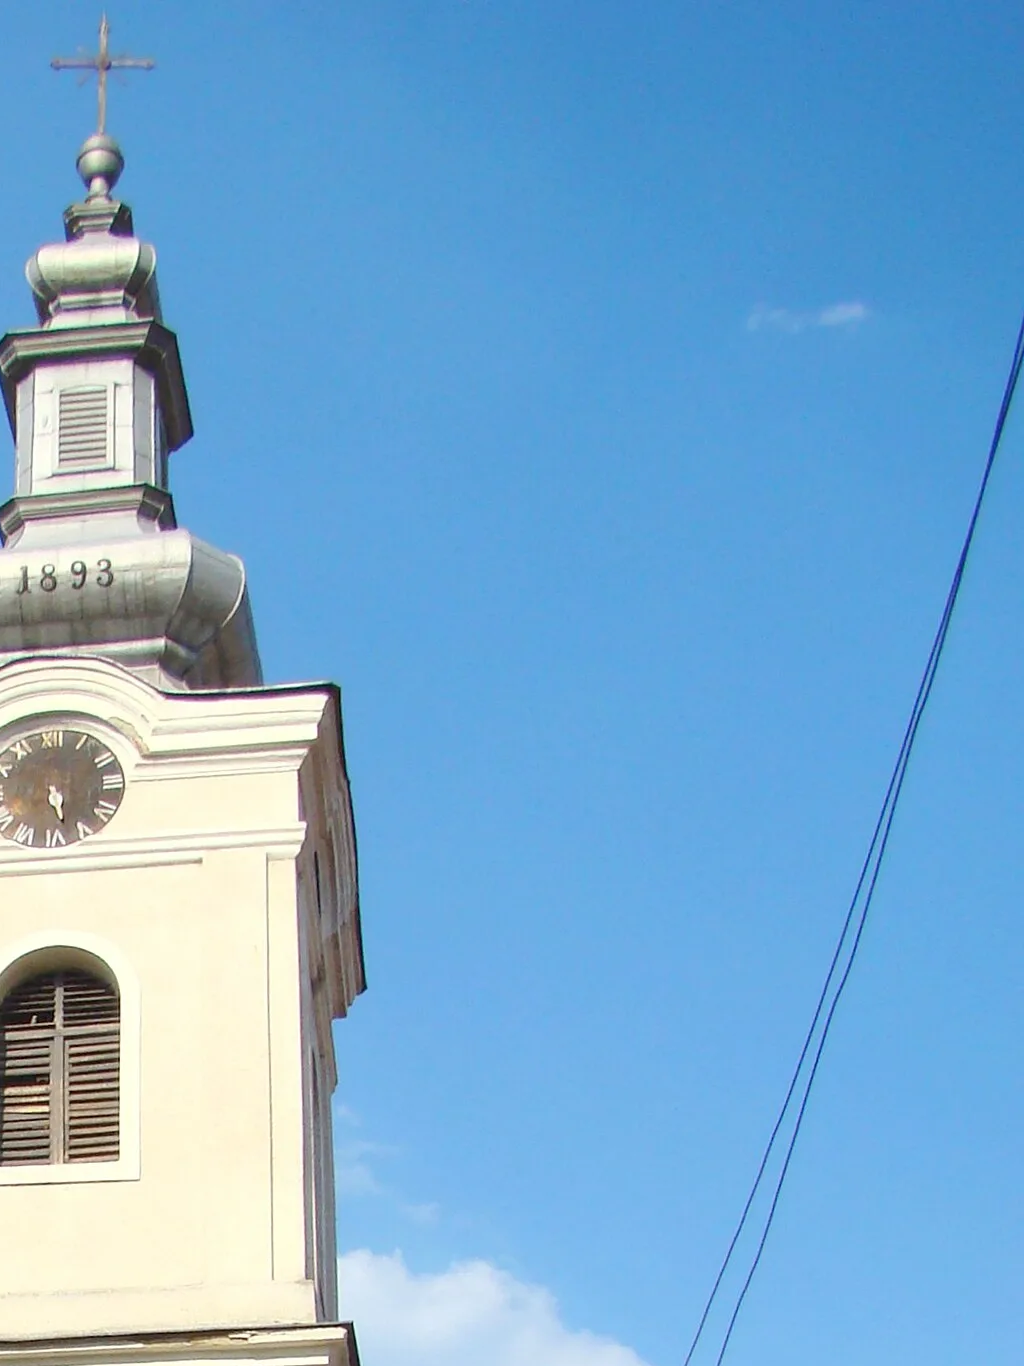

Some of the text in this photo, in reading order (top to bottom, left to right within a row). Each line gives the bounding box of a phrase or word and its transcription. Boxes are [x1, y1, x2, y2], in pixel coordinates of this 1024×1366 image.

[16, 558, 114, 595] 1893
[41, 731, 63, 748] XII
[9, 739, 33, 761] XI
[94, 752, 115, 769] II
[102, 774, 123, 790] III
[45, 828, 67, 847] VI
[76, 821, 94, 840] V
